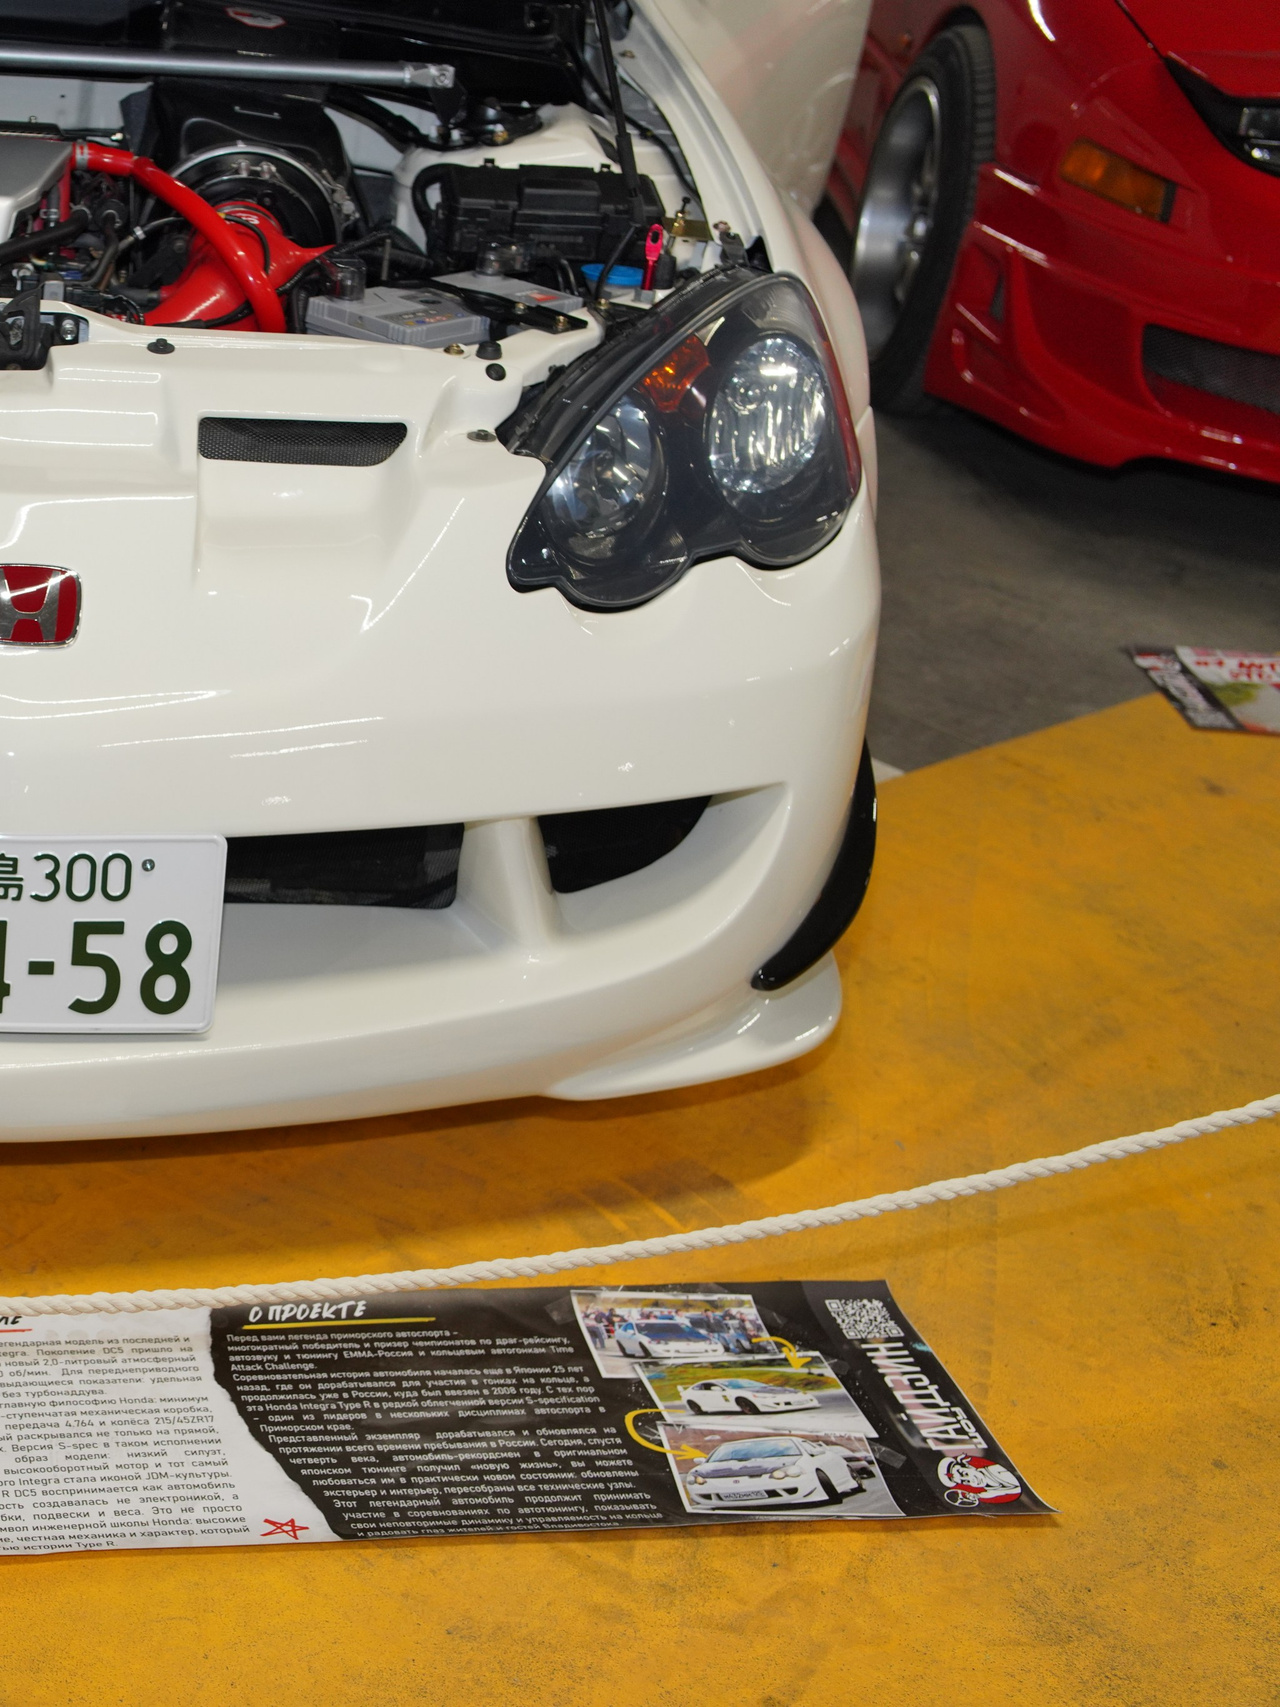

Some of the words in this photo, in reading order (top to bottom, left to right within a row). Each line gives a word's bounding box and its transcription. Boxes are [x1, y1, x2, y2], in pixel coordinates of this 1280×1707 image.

[248, 1306, 263, 1323] О
[268, 1300, 368, 1322] ПРОЕКТЕ
[36, 1347, 96, 1356] Поколение
[102, 1346, 125, 1354] DC5
[130, 1346, 174, 1355] пришло
[0, 1380, 74, 1389] выдающиеся
[149, 1375, 203, 1384] удельная
[860, 1342, 977, 1451] ГАЙДЗИН
[79, 1408, 161, 1416] механическая
[16, 1432, 93, 1442] раскрывался
[114, 1429, 153, 1437] только
[11, 1443, 54, 1453] Версия
[58, 1441, 99, 1452] S-spec
[114, 1440, 149, 1448] таком
[152, 1438, 222, 1446] исполнении
[14, 1454, 49, 1464] образ
[126, 1449, 168, 1458] низкий
[3, 1463, 110, 1476] высокооборотный
[115, 1463, 150, 1472] мотор
[191, 1458, 229, 1467] самый
[18, 1476, 61, 1487] Integra
[63, 1476, 97, 1484] стала
[99, 1473, 142, 1482] иконой
[14, 1488, 37, 1497] DC5
[41, 1486, 139, 1497] воспринимается
[167, 1480, 236, 1490] автомобиль
